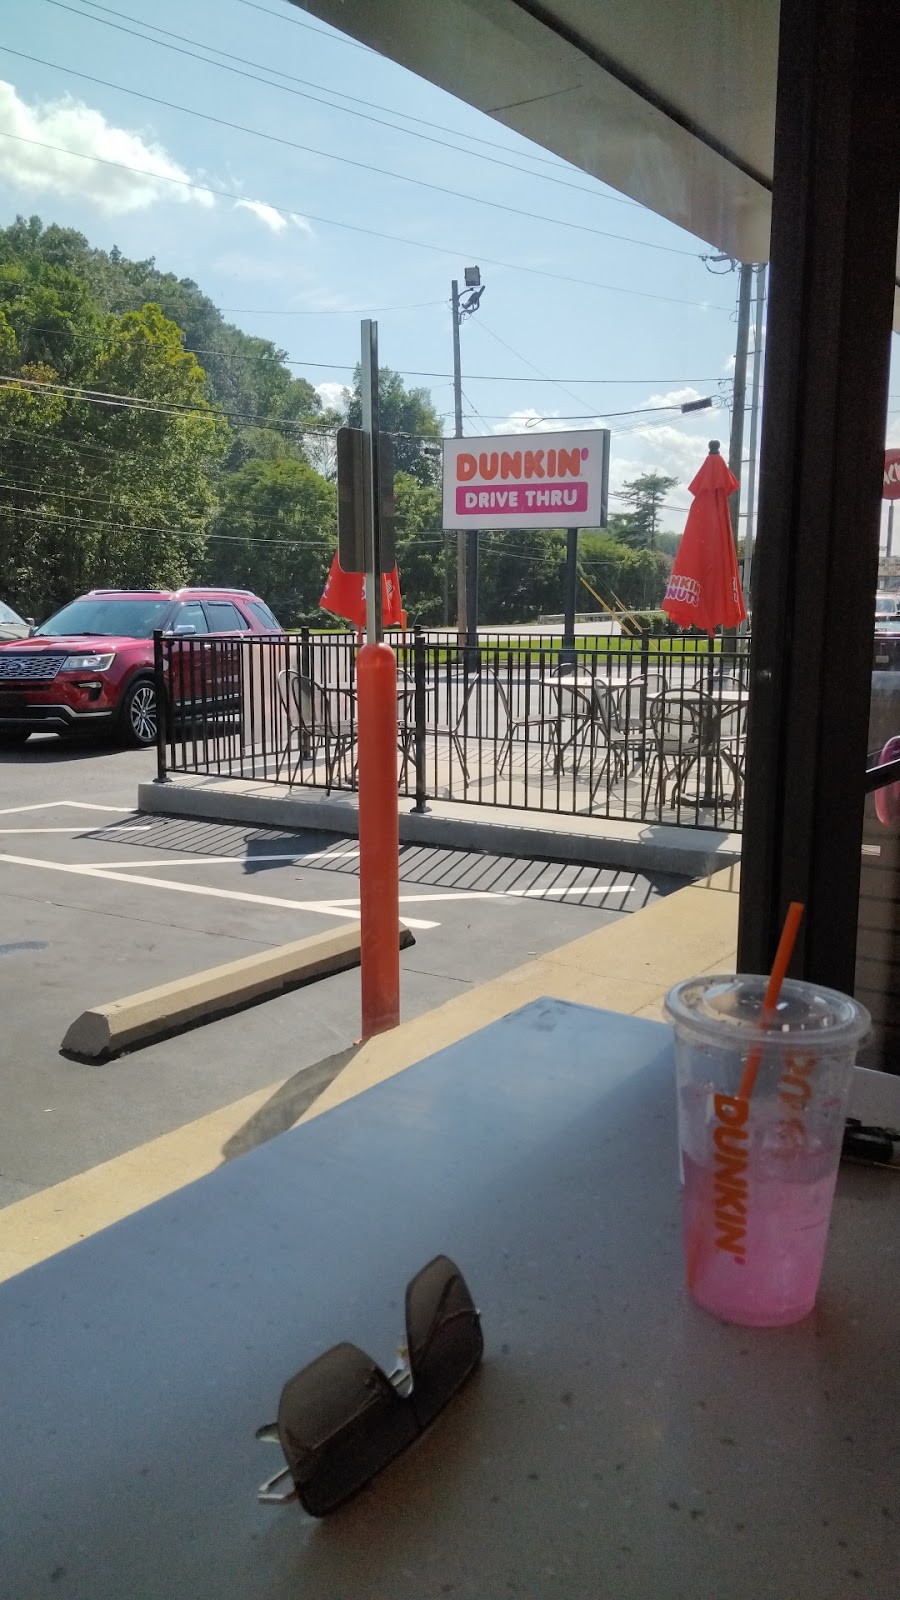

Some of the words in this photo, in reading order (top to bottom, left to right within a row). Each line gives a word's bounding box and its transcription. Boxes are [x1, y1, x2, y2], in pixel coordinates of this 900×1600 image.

[456, 447, 589, 482] DUNKIN'
[465, 490, 518, 509] DRIVE
[525, 488, 578, 507] THRU
[713, 1092, 750, 1266] DUNKIN'
